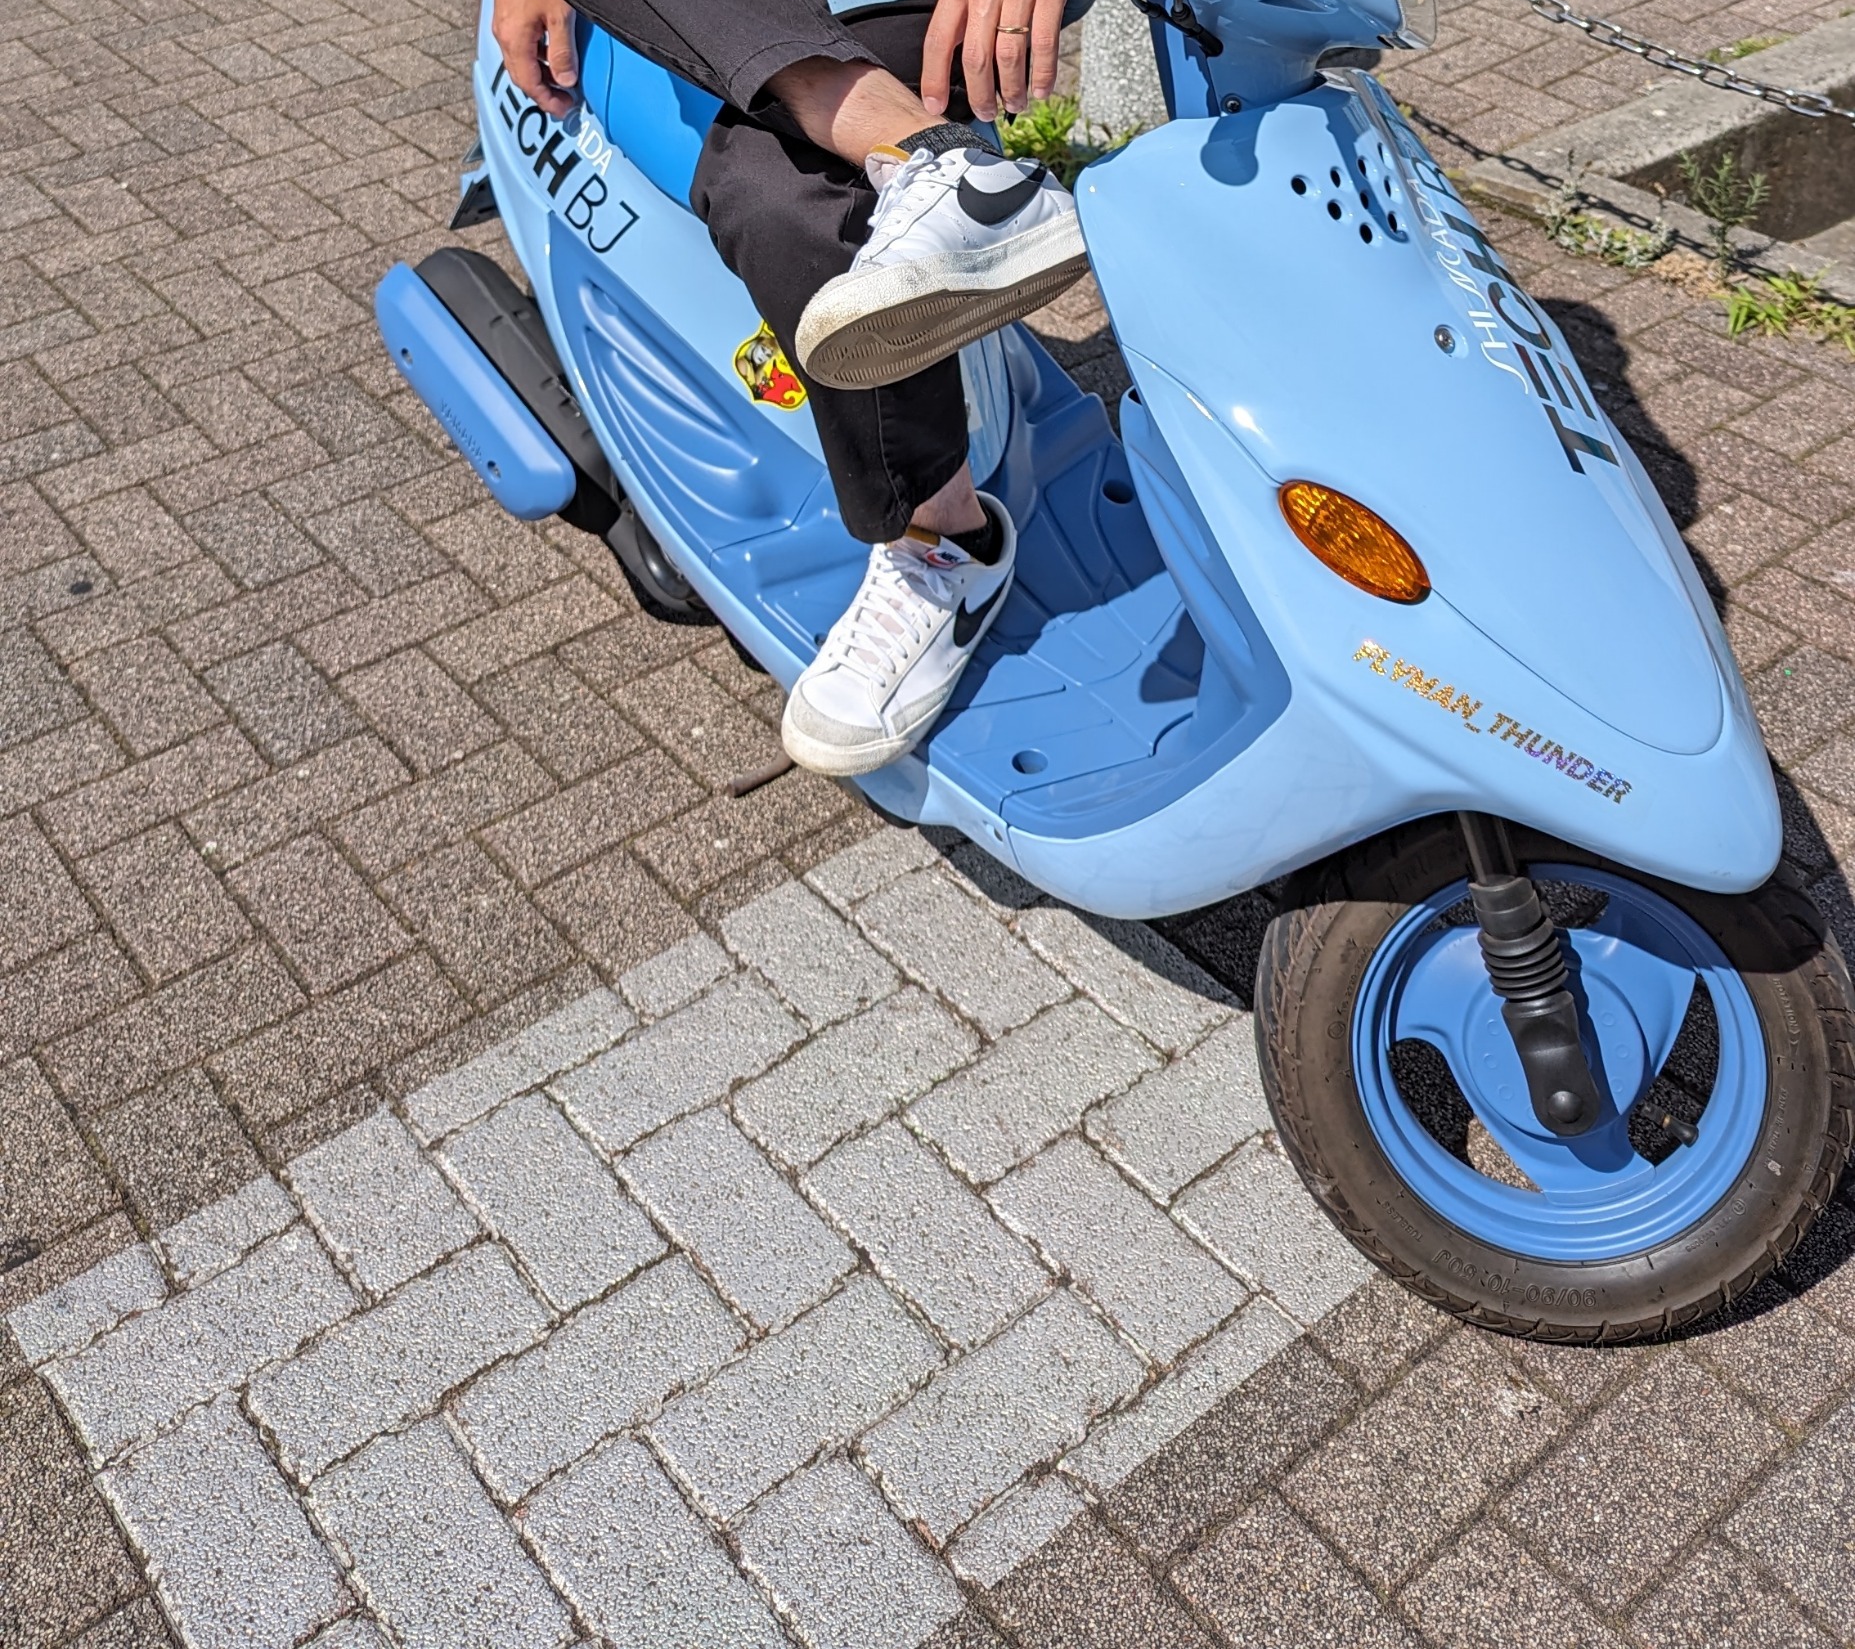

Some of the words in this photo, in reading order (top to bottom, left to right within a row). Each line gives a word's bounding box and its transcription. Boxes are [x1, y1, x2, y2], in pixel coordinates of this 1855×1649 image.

[564, 172, 641, 253] BJ
[1439, 209, 1621, 476] TECH
[1352, 639, 1633, 805] FLYMAN_THUNDER
[1771, 977, 1800, 1029] ROTATION
[1382, 1200, 1425, 1244] TUBELESS
